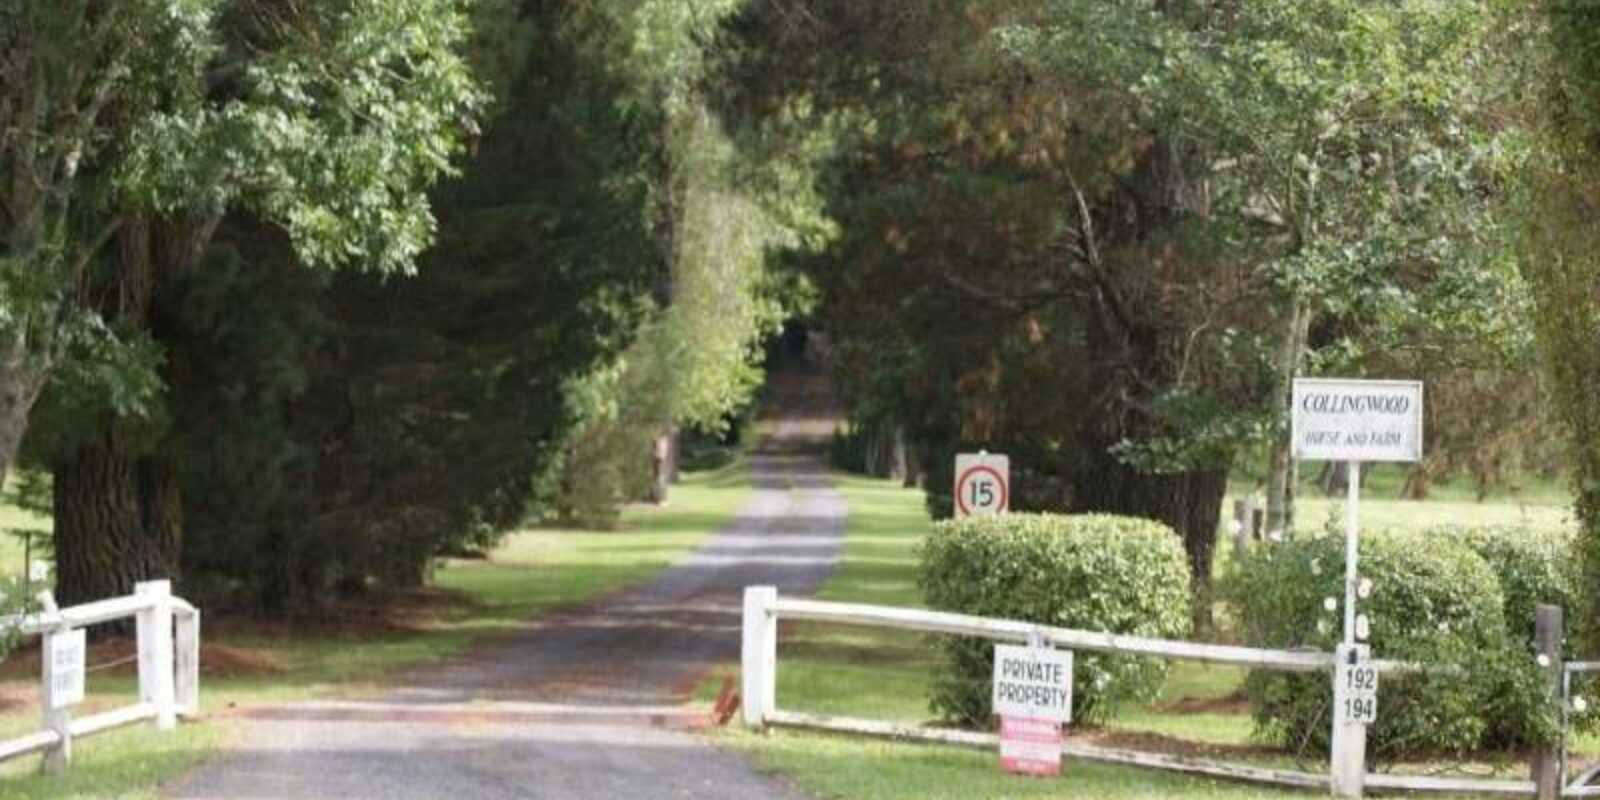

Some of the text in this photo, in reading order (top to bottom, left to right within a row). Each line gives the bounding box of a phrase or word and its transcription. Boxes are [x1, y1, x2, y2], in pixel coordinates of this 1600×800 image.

[1303, 392, 1409, 413] COLLINGWOOD
[970, 480, 993, 507] 15
[1002, 658, 1063, 683] PRIVATE
[1347, 668, 1375, 689] 192
[998, 681, 1066, 710] PROPERTY
[1344, 698, 1373, 719] 194
